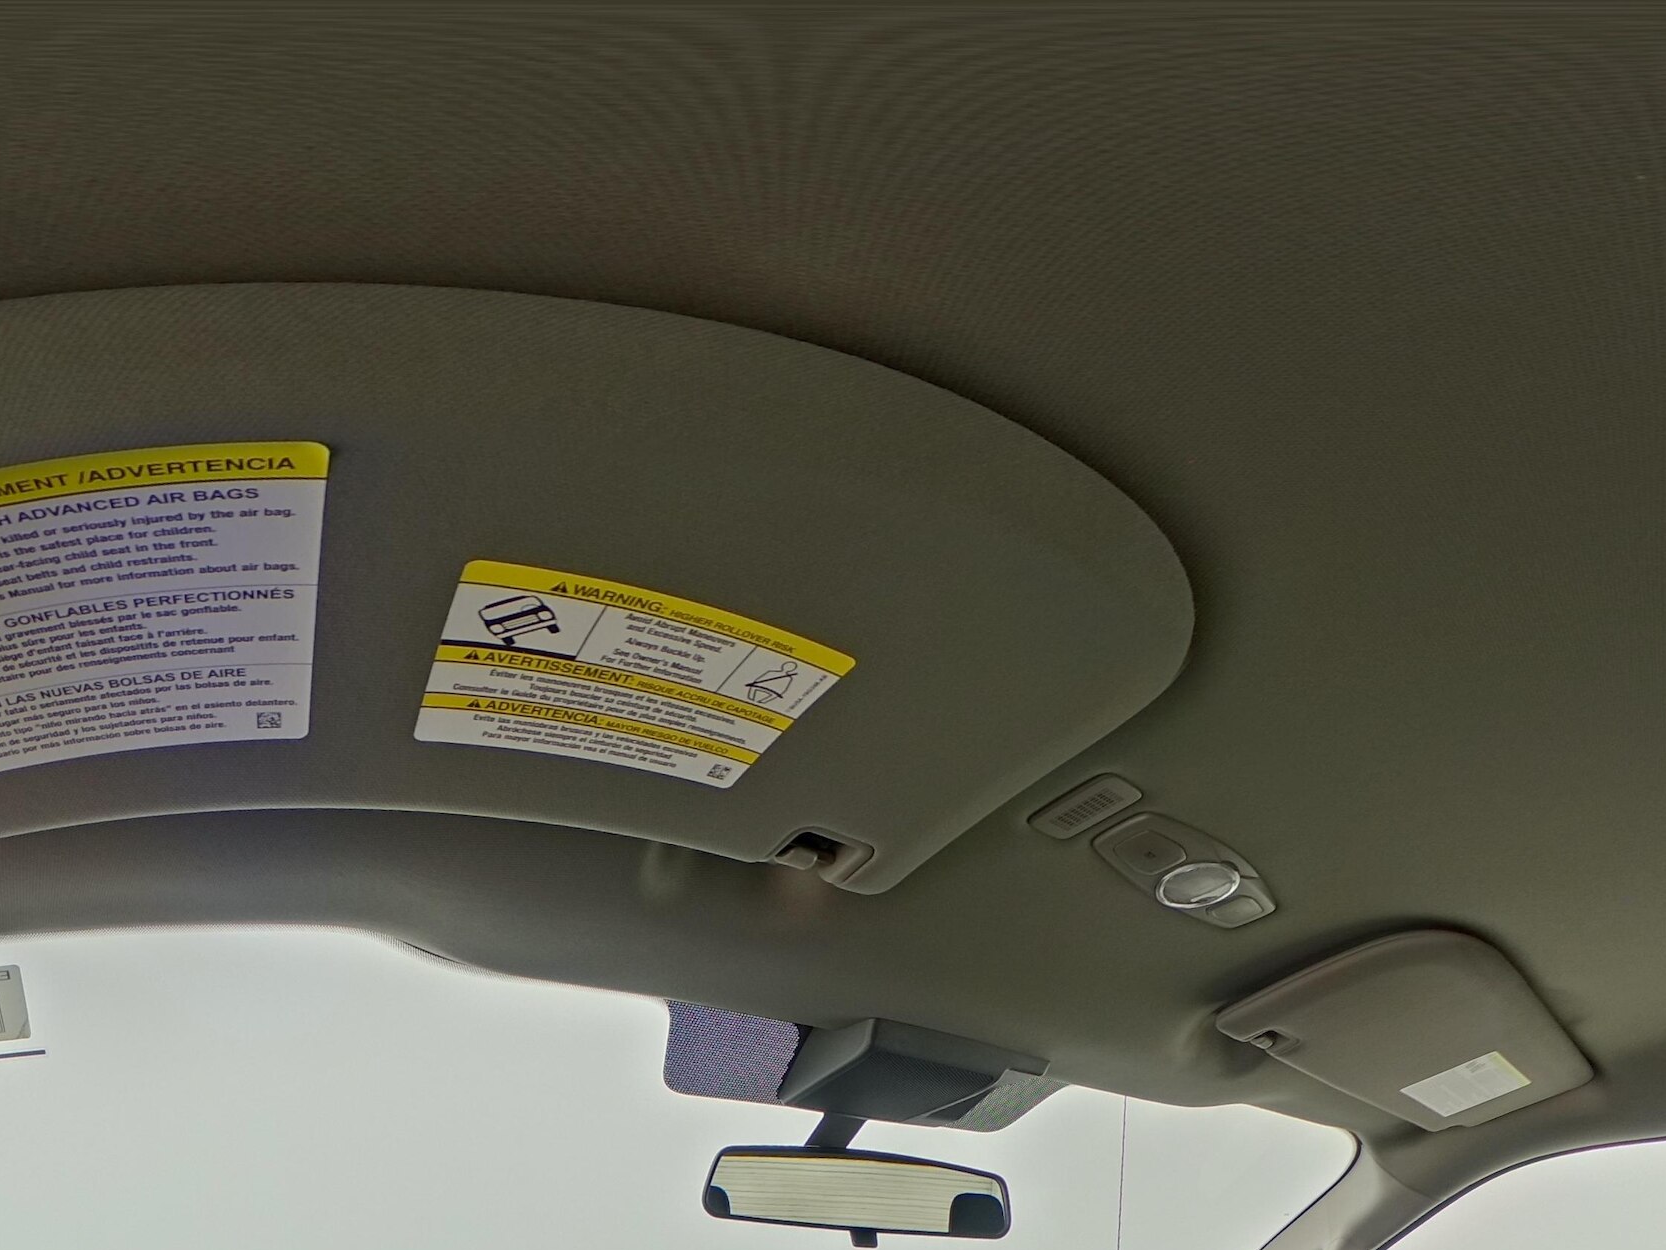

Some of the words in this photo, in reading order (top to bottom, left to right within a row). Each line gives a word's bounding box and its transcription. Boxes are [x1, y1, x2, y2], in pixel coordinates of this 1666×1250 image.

[17, 496, 141, 523] ADVANCED
[146, 491, 187, 506] AIR
[192, 487, 260, 502] BAGS
[0, 530, 40, 545] killed
[42, 528, 57, 537] or
[61, 519, 127, 534] seriously
[130, 513, 184, 526] injured
[187, 512, 206, 522] by
[209, 510, 235, 520] the
[238, 509, 260, 518] air
[263, 508, 297, 518] bag.
[12, 546, 37, 556] the
[39, 537, 83, 552] safest
[85, 533, 125, 546] place
[127, 530, 149, 540] for
[152, 525, 217, 538] children.
[24, 570, 59, 582] belts
[61, 564, 87, 576] and
[89, 559, 124, 572] child
[126, 554, 198, 567] restraints.
[63, 549, 99, 562] child
[101, 545, 132, 557] seat
[134, 544, 150, 553] in
[151, 542, 176, 551] the
[178, 538, 219, 549] front.
[7, 582, 56, 599] Manual
[56, 580, 76, 590] for
[79, 575, 114, 586] more
[116, 567, 195, 582] information
[198, 564, 238, 574] about
[240, 562, 260, 572] air
[262, 563, 300, 572] bags.
[3, 599, 129, 629] GONFLABLES
[132, 588, 295, 609] PERFECTIONNÉS
[572, 583, 669, 615] WARNING:
[668, 609, 715, 627] HIGHER
[712, 621, 772, 646] ROLLOVER
[769, 640, 797, 654] RISK
[623, 612, 655, 625] Avoid
[652, 619, 688, 634] Abrupt
[686, 628, 737, 648] Maneuvers
[625, 624, 647, 633] and
[645, 627, 693, 645] Excessive
[692, 639, 723, 654] Speed.
[612, 647, 631, 658] See
[631, 652, 670, 667] Owner's
[669, 661, 704, 676] Manual
[624, 637, 660, 651] Always
[659, 645, 692, 659] Buckle
[691, 653, 706, 663] Up.
[4, 692, 37, 707] LAS
[39, 681, 105, 700] NUEVAS
[107, 672, 177, 689] BOLSAS
[179, 670, 204, 681] DE
[206, 667, 248, 679] AIRE
[599, 654, 618, 664] For
[617, 658, 653, 672] Further
[652, 666, 704, 685] Information
[481, 651, 635, 687] AVERTISSEMENT:
[635, 680, 677, 695] RISQUE
[674, 690, 712, 704] ACCRU
[710, 699, 727, 709] DE
[725, 703, 776, 725] CAPOTAGE
[483, 699, 605, 727] ADVERTENCIA:
[603, 720, 642, 735] MAYOR
[640, 728, 679, 742] RIESGO
[677, 736, 693, 745] DE
[693, 740, 730, 755] VUELCO
